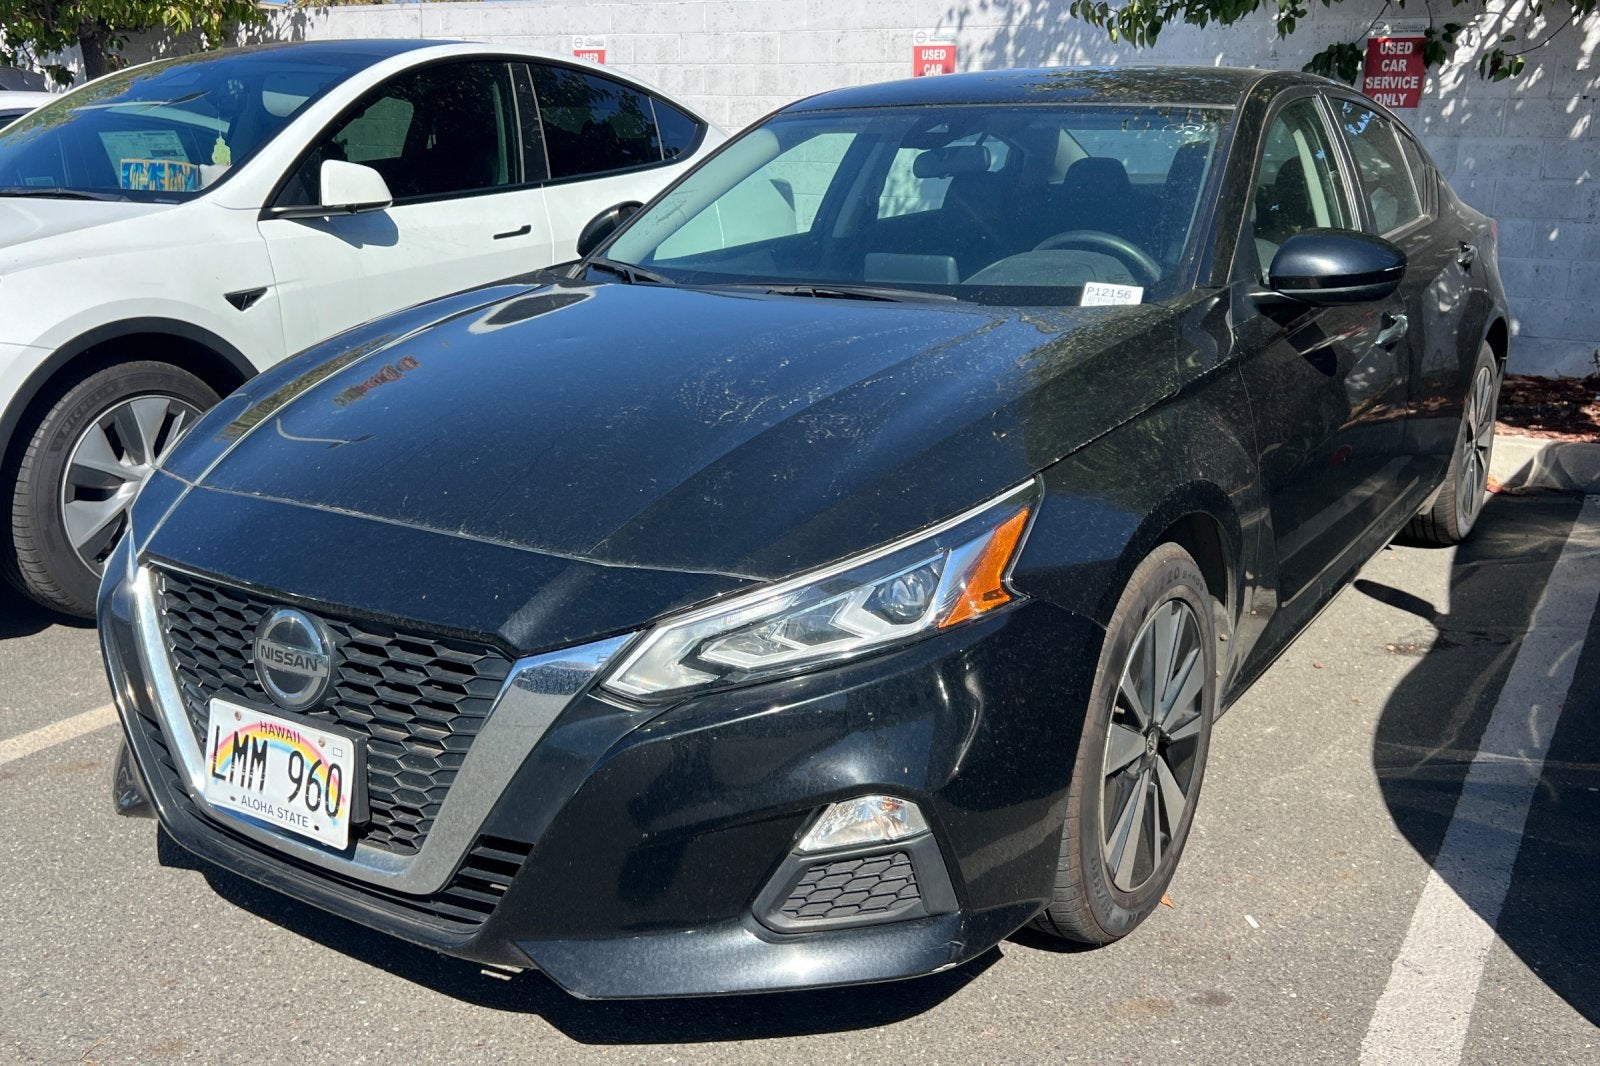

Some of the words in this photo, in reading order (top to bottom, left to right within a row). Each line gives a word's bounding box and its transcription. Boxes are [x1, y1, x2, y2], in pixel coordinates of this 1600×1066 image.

[921, 49, 946, 61] USED
[1380, 42, 1413, 55] USED
[924, 63, 943, 77] CAR
[1381, 59, 1407, 72] CAR
[1366, 76, 1419, 89] SERVICE
[1373, 93, 1408, 106] ONLY
[1087, 286, 1132, 299] P12156
[260, 644, 319, 672] NISSAN
[259, 720, 301, 744] HAWAII
[212, 725, 268, 793] LMM
[288, 751, 342, 818] 960
[241, 795, 274, 815] ALOHA
[277, 808, 309, 828] STATE
